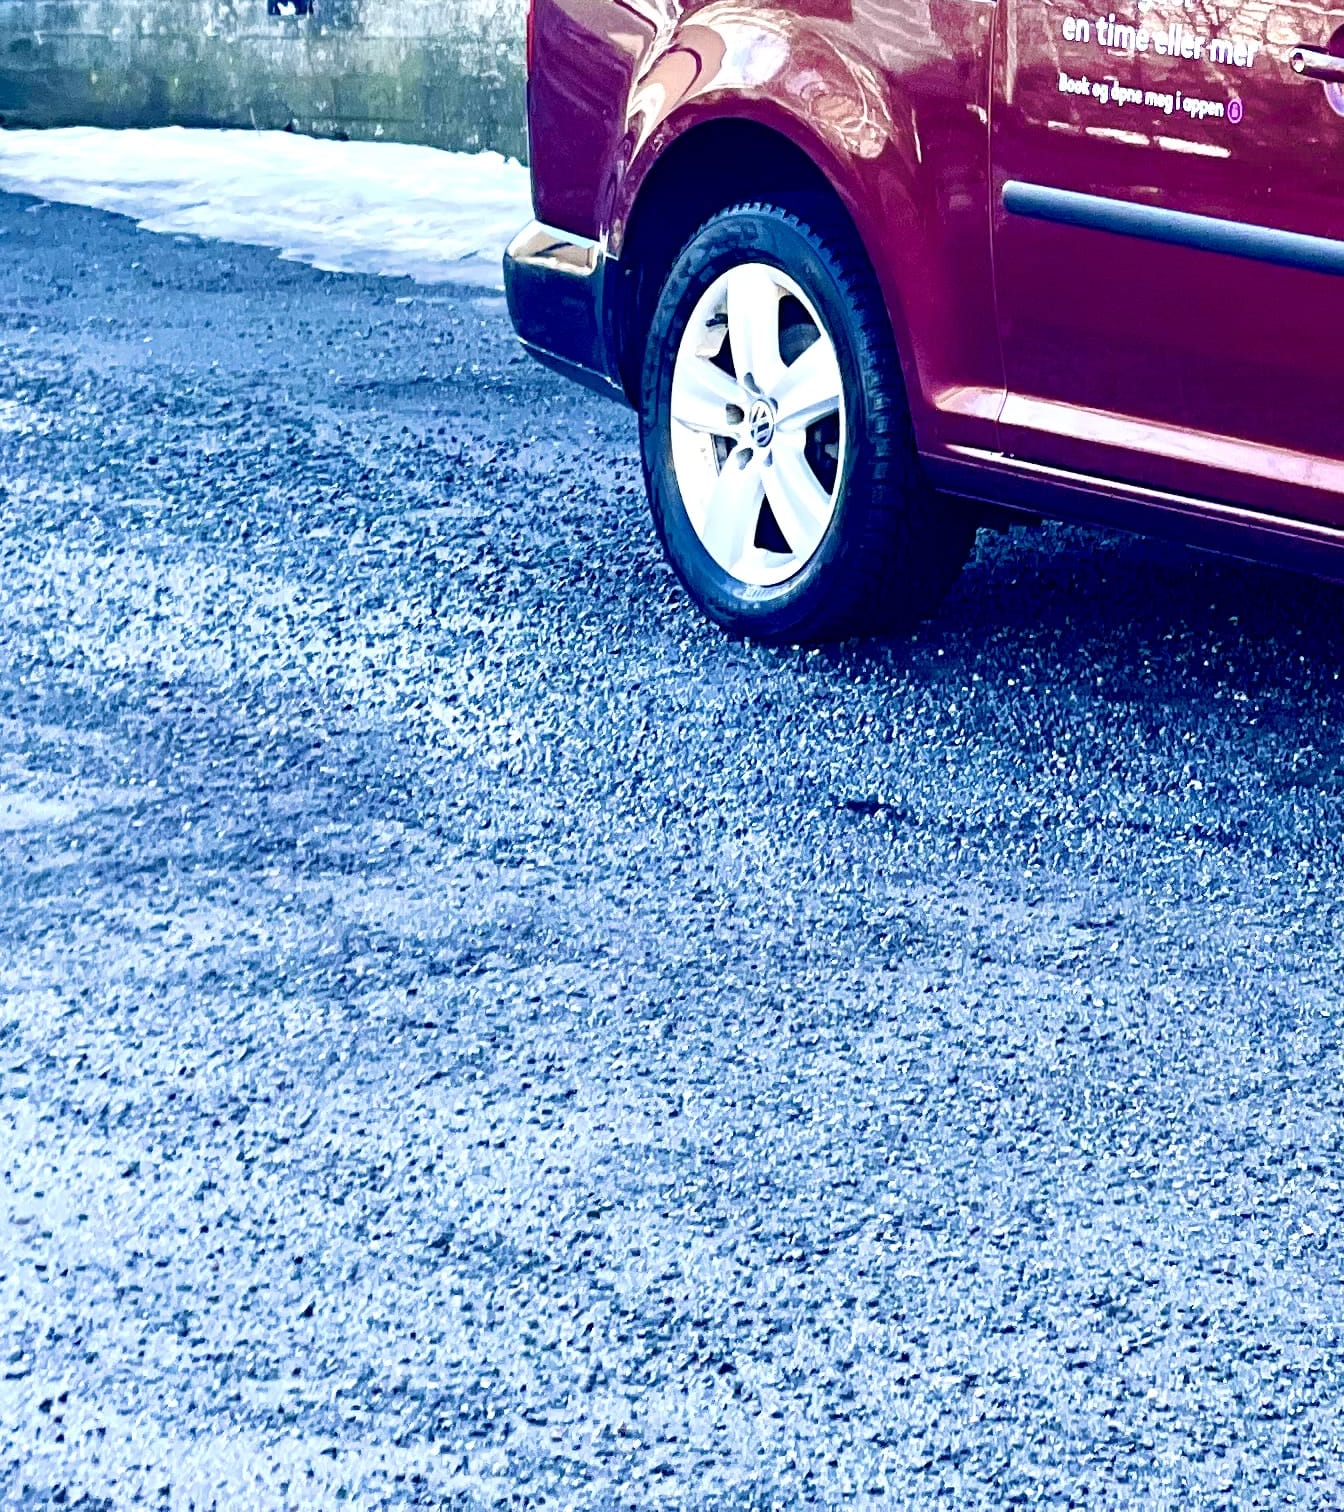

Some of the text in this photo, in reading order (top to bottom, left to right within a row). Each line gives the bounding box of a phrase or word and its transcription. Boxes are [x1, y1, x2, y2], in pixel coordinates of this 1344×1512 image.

[1062, 13, 1259, 68] en time eller mer
[1058, 72, 1091, 96] Book
[1092, 82, 1109, 104] og
[1144, 90, 1174, 115] meg
[1175, 90, 1182, 111] i
[1183, 98, 1225, 119] appen
